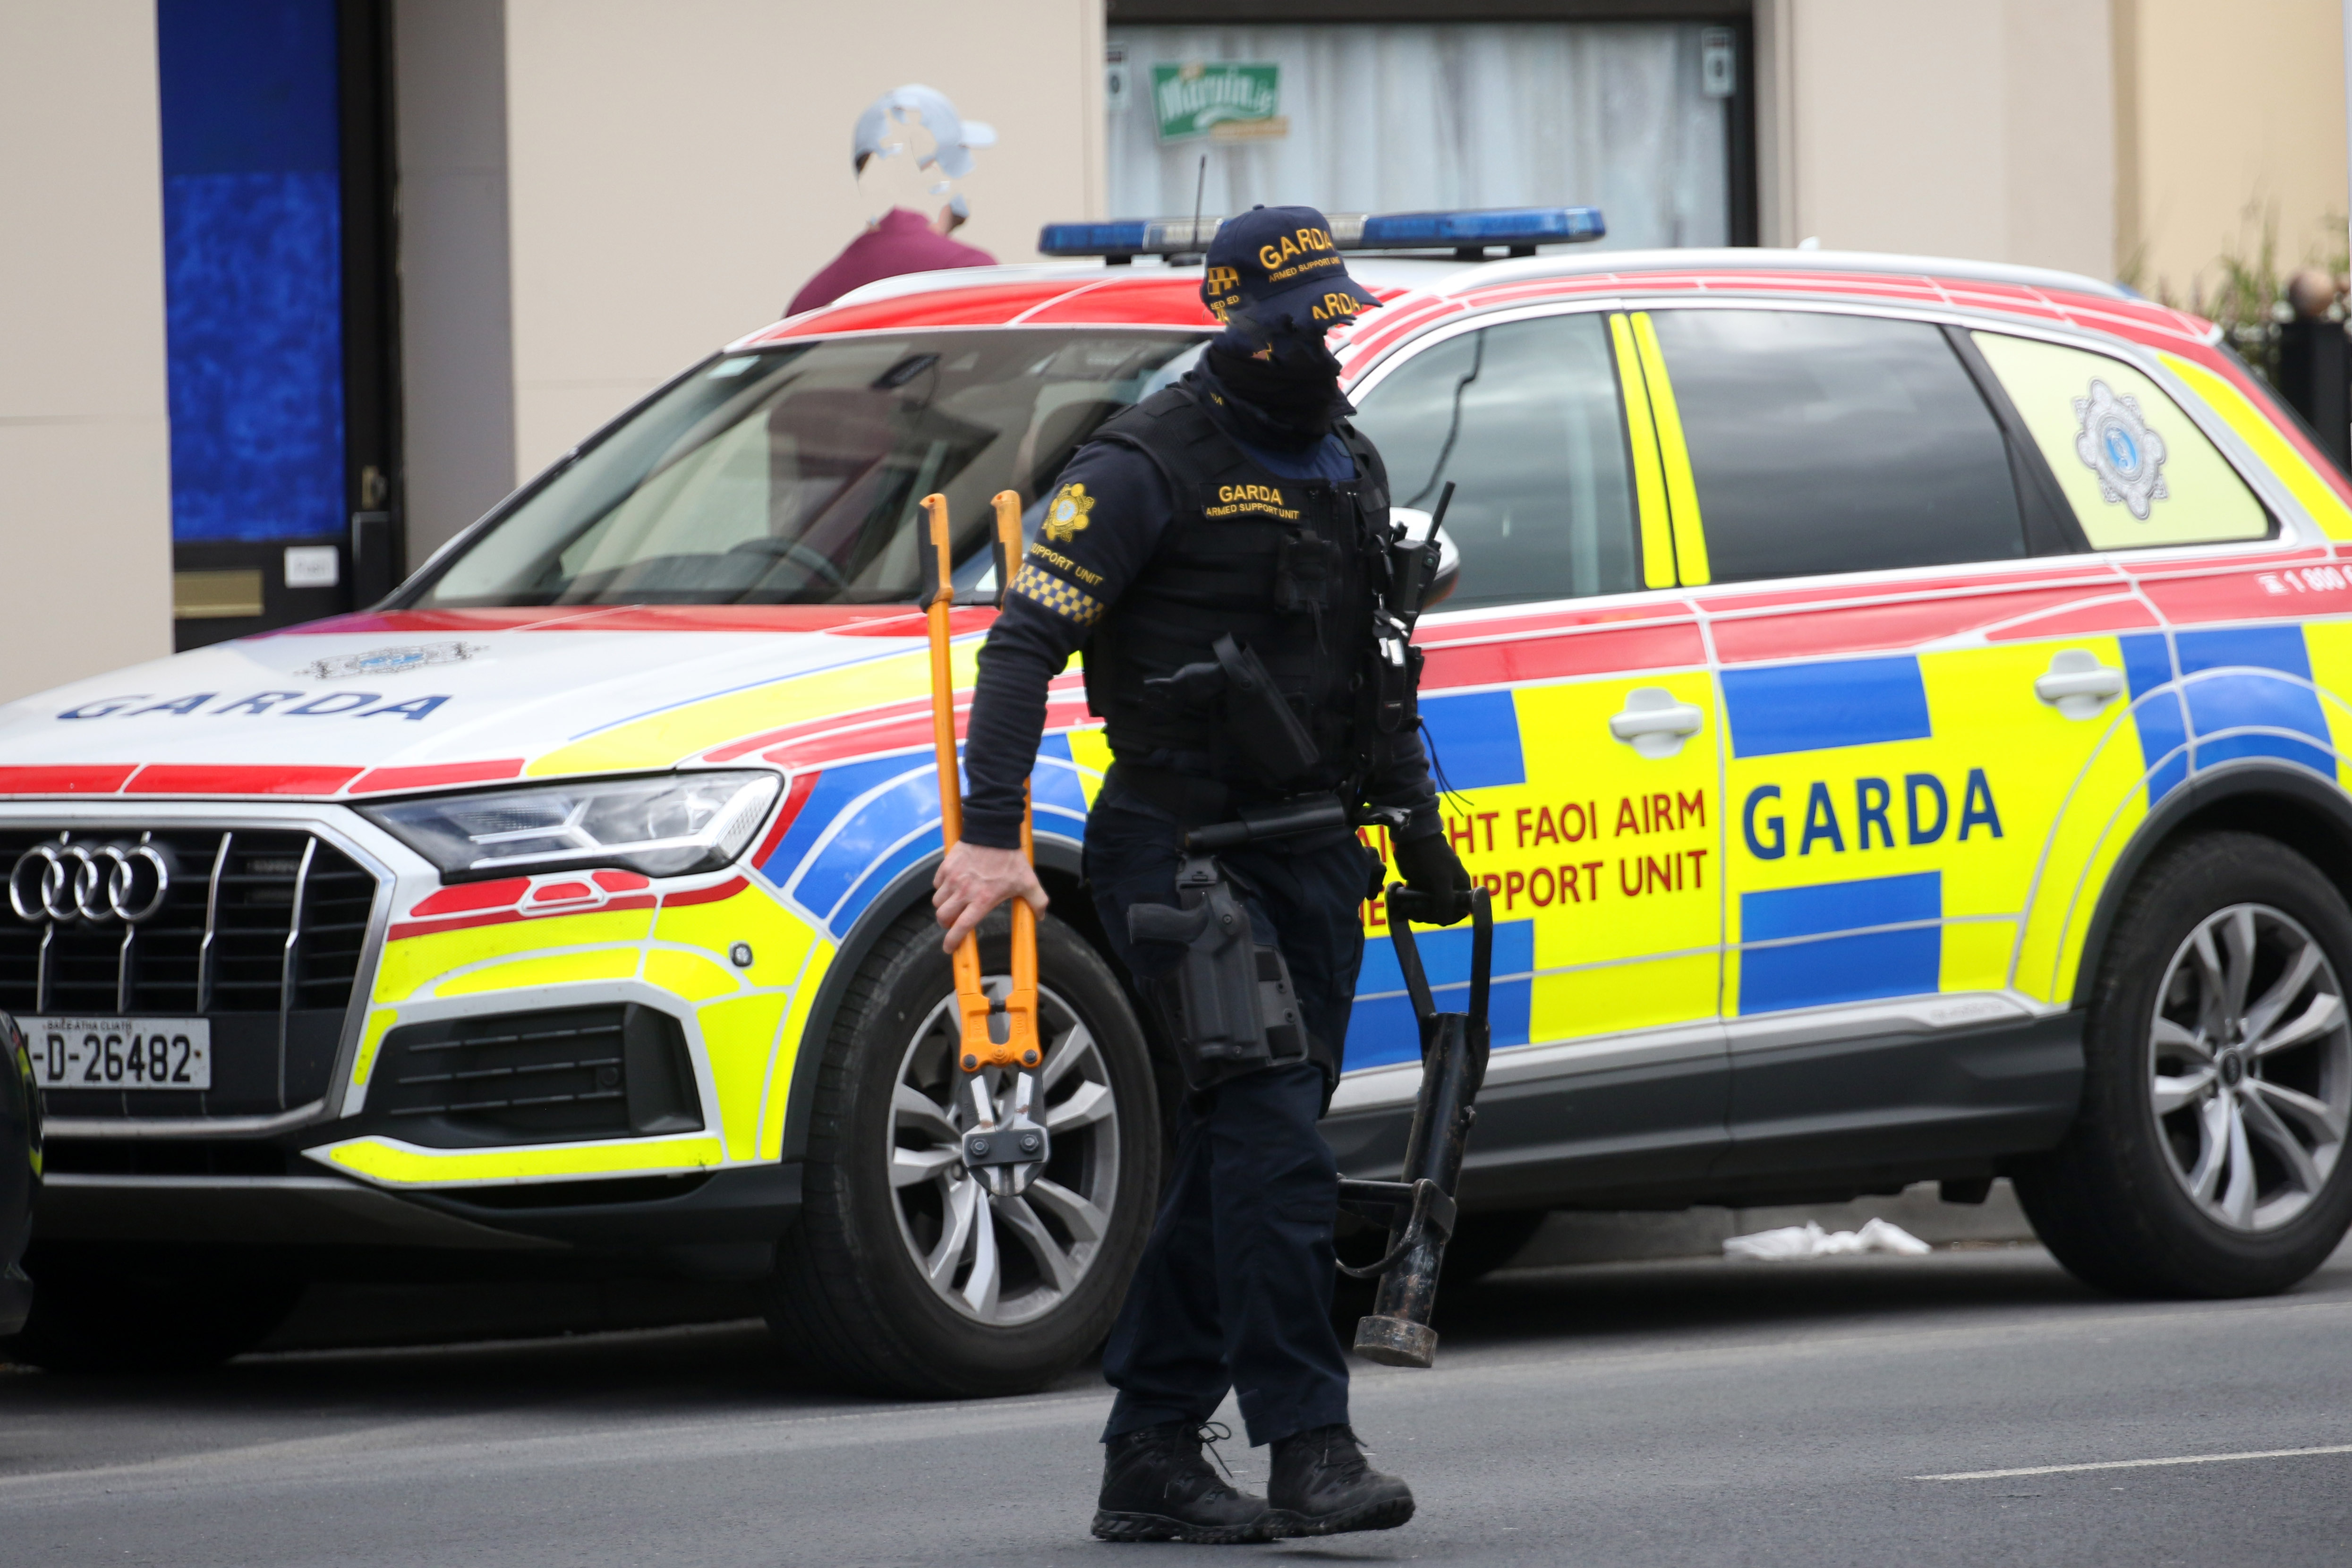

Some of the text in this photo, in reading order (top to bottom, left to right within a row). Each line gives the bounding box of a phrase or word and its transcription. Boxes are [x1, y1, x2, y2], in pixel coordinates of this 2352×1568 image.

[1259, 228, 1335, 269] GARDA
[1268, 266, 1297, 283] ARMED
[1298, 258, 1330, 272] SUPPORT
[1219, 485, 1285, 506] GARDA
[1206, 503, 1299, 520] ARMED SUPPORT UNIT
[1075, 566, 1103, 586] UNIT
[56, 691, 453, 720] GARDA
[1517, 801, 1597, 848] FAOI
[1614, 789, 1705, 837] AIRM
[1742, 767, 2003, 860] GARDA
[1620, 850, 1707, 897] UNIT
